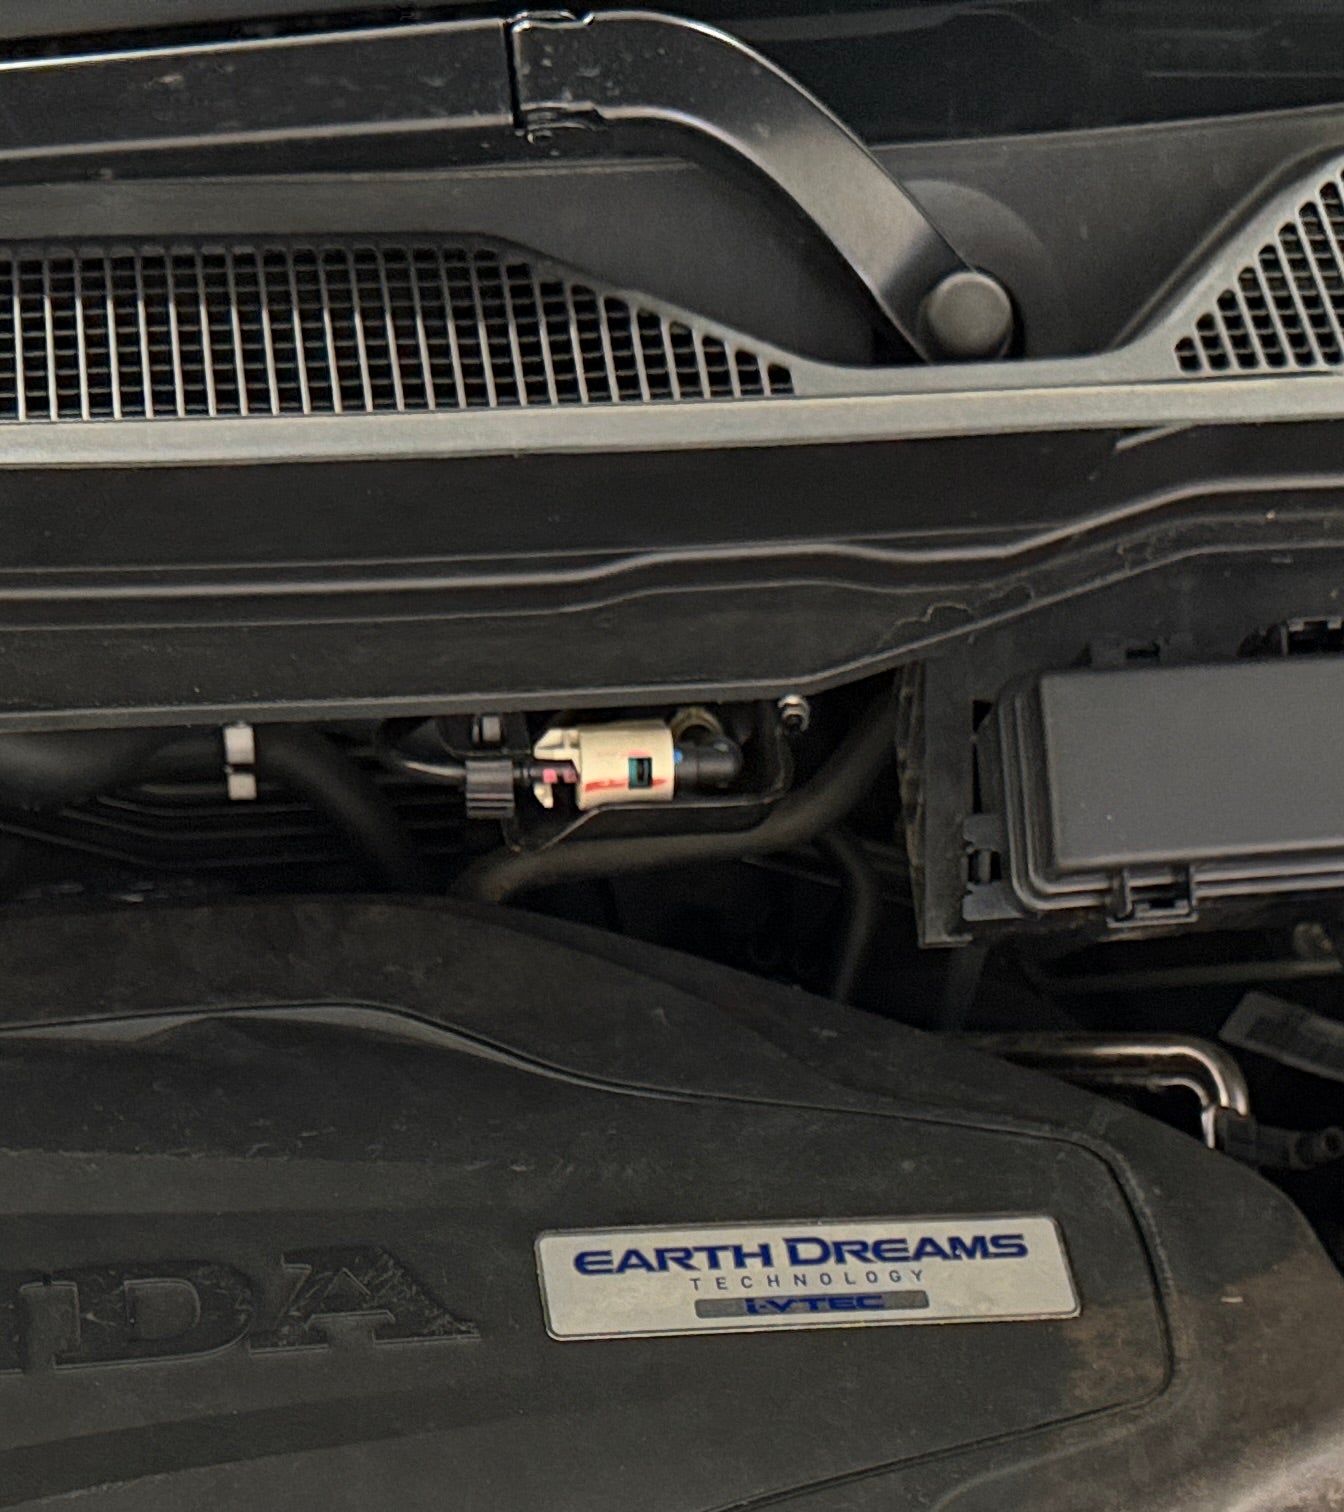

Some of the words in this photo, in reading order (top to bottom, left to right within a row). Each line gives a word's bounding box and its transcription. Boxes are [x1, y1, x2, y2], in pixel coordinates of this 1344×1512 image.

[573, 1243, 774, 1276] EARTH
[782, 1233, 1029, 1267] DREAMS
[689, 1268, 926, 1292] TECHNOLOGY
[744, 1293, 885, 1316] i-VTEC
